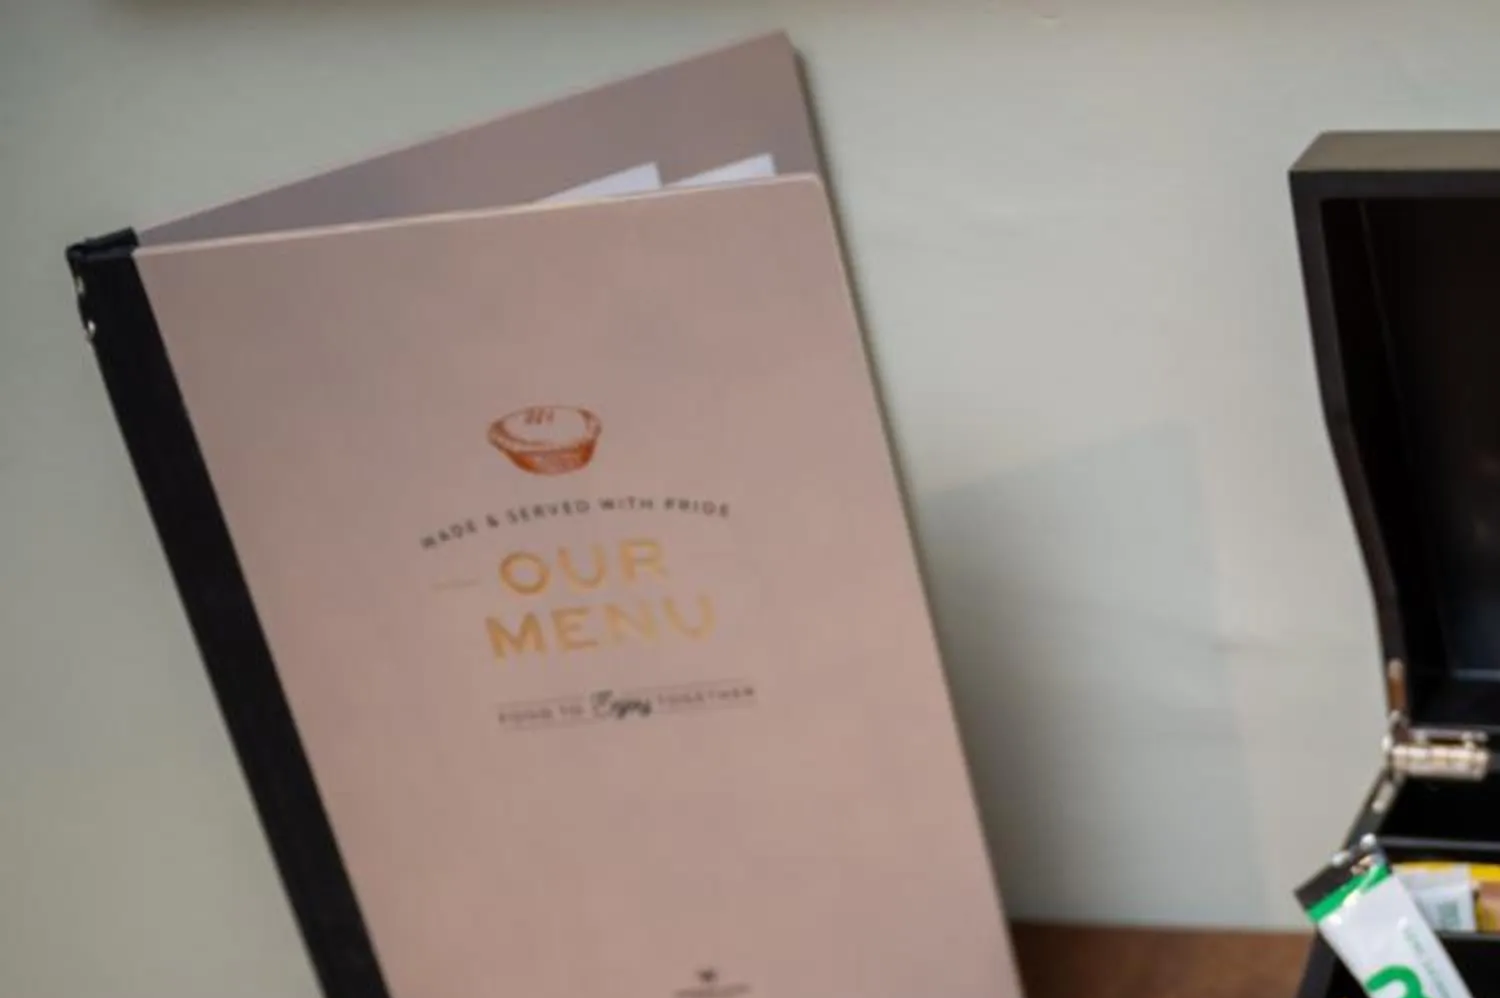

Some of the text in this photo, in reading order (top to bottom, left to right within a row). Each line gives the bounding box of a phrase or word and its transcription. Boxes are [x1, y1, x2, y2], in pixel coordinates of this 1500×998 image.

[420, 496, 730, 549] MADE & SERVED WITH PRIDE
[499, 537, 669, 595] OUR
[485, 595, 718, 660] MENU
